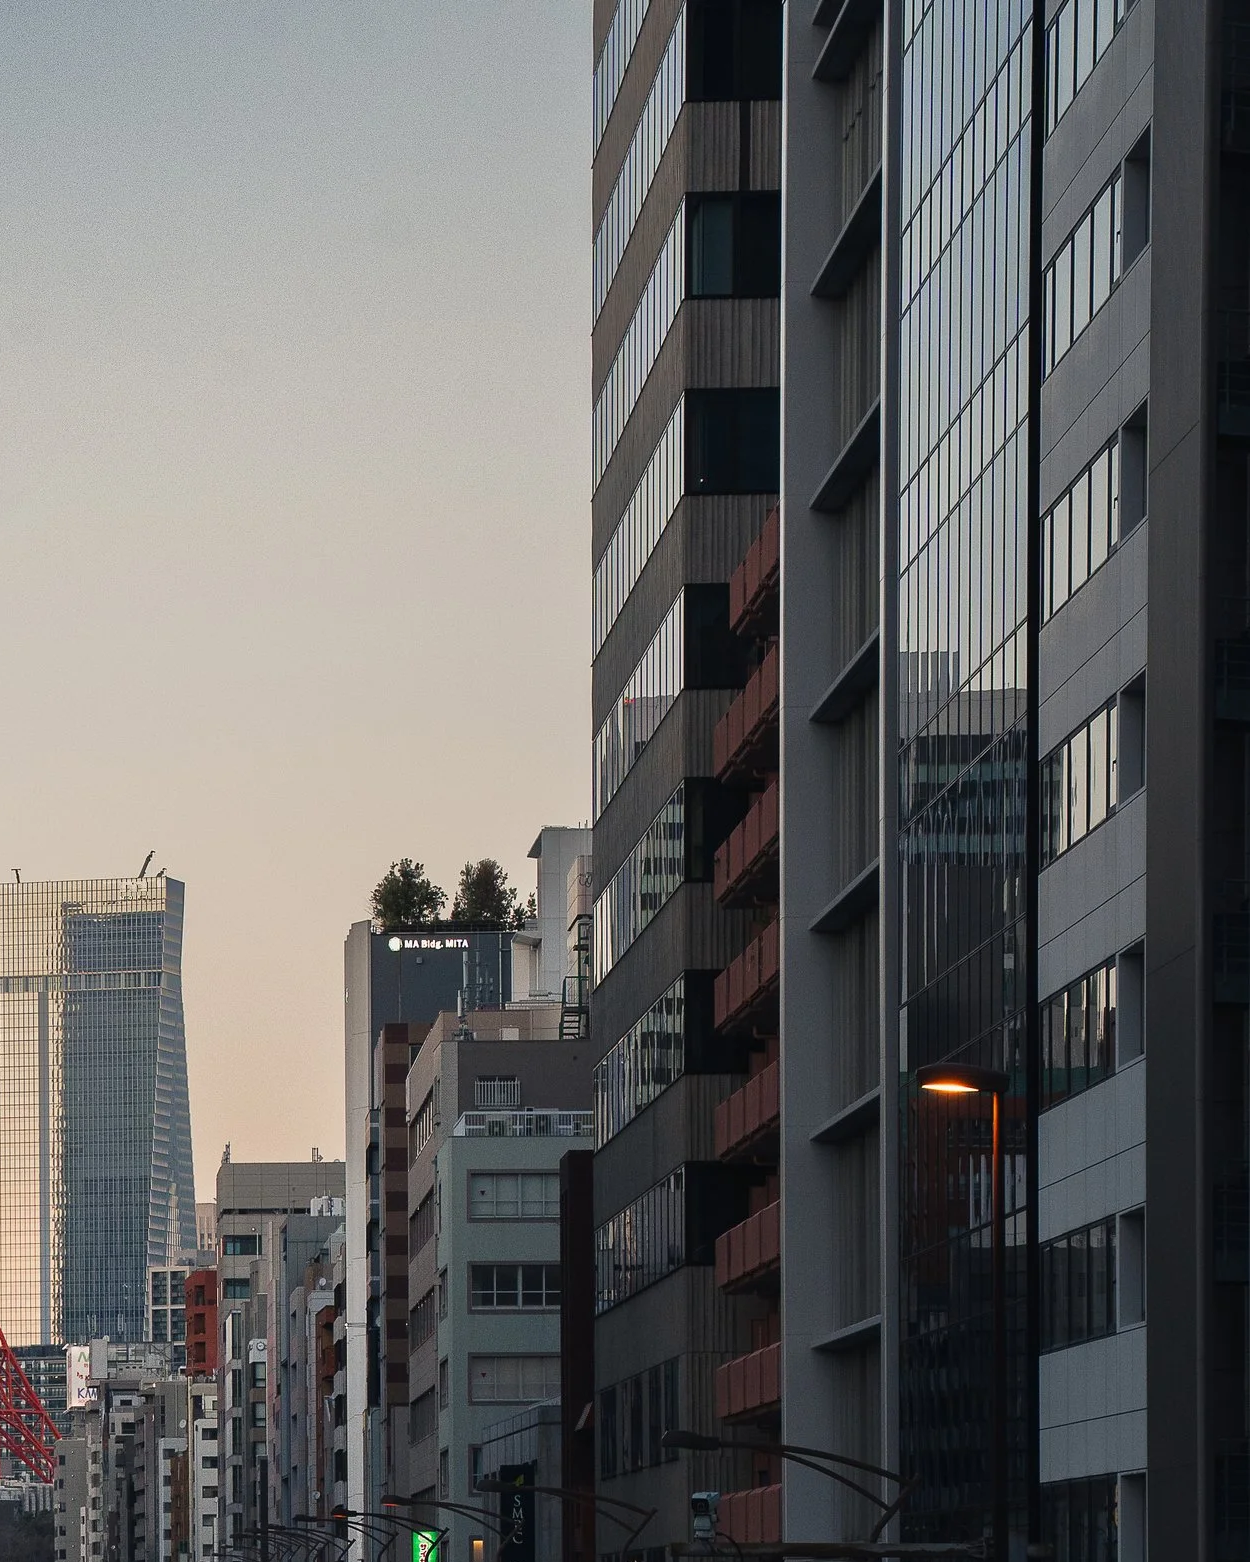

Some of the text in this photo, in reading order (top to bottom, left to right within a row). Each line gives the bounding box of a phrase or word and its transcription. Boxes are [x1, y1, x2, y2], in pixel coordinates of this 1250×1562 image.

[405, 938, 469, 950] MA Bldg. MITA
